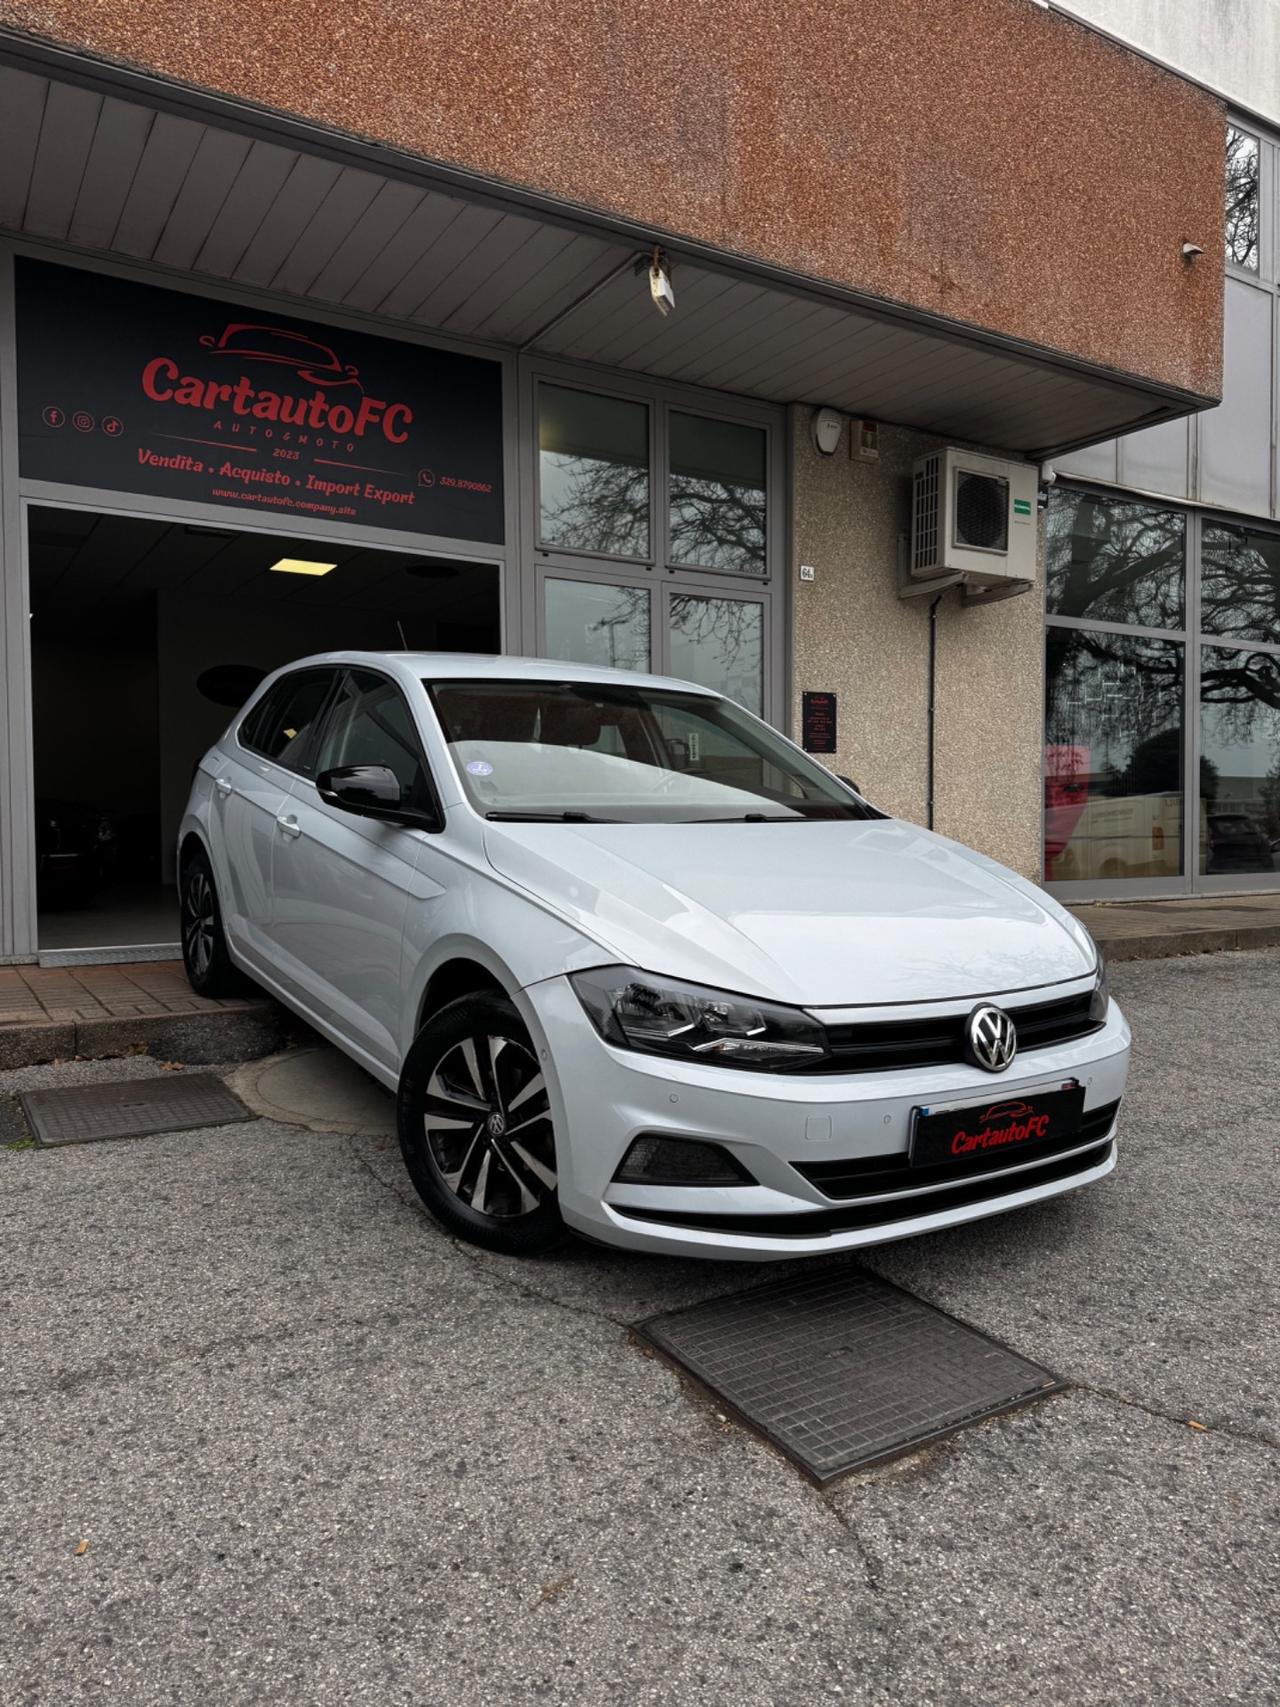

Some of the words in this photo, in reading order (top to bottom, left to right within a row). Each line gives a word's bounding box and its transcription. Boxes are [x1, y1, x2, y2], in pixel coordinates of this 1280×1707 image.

[141, 357, 414, 444] CartautoFC
[138, 447, 204, 473] Vendita
[219, 461, 291, 485] Acquisto
[305, 474, 361, 496] Import
[363, 482, 416, 504] Export
[272, 447, 300, 460] 2023
[951, 1114, 1050, 1155] CartautoFC
